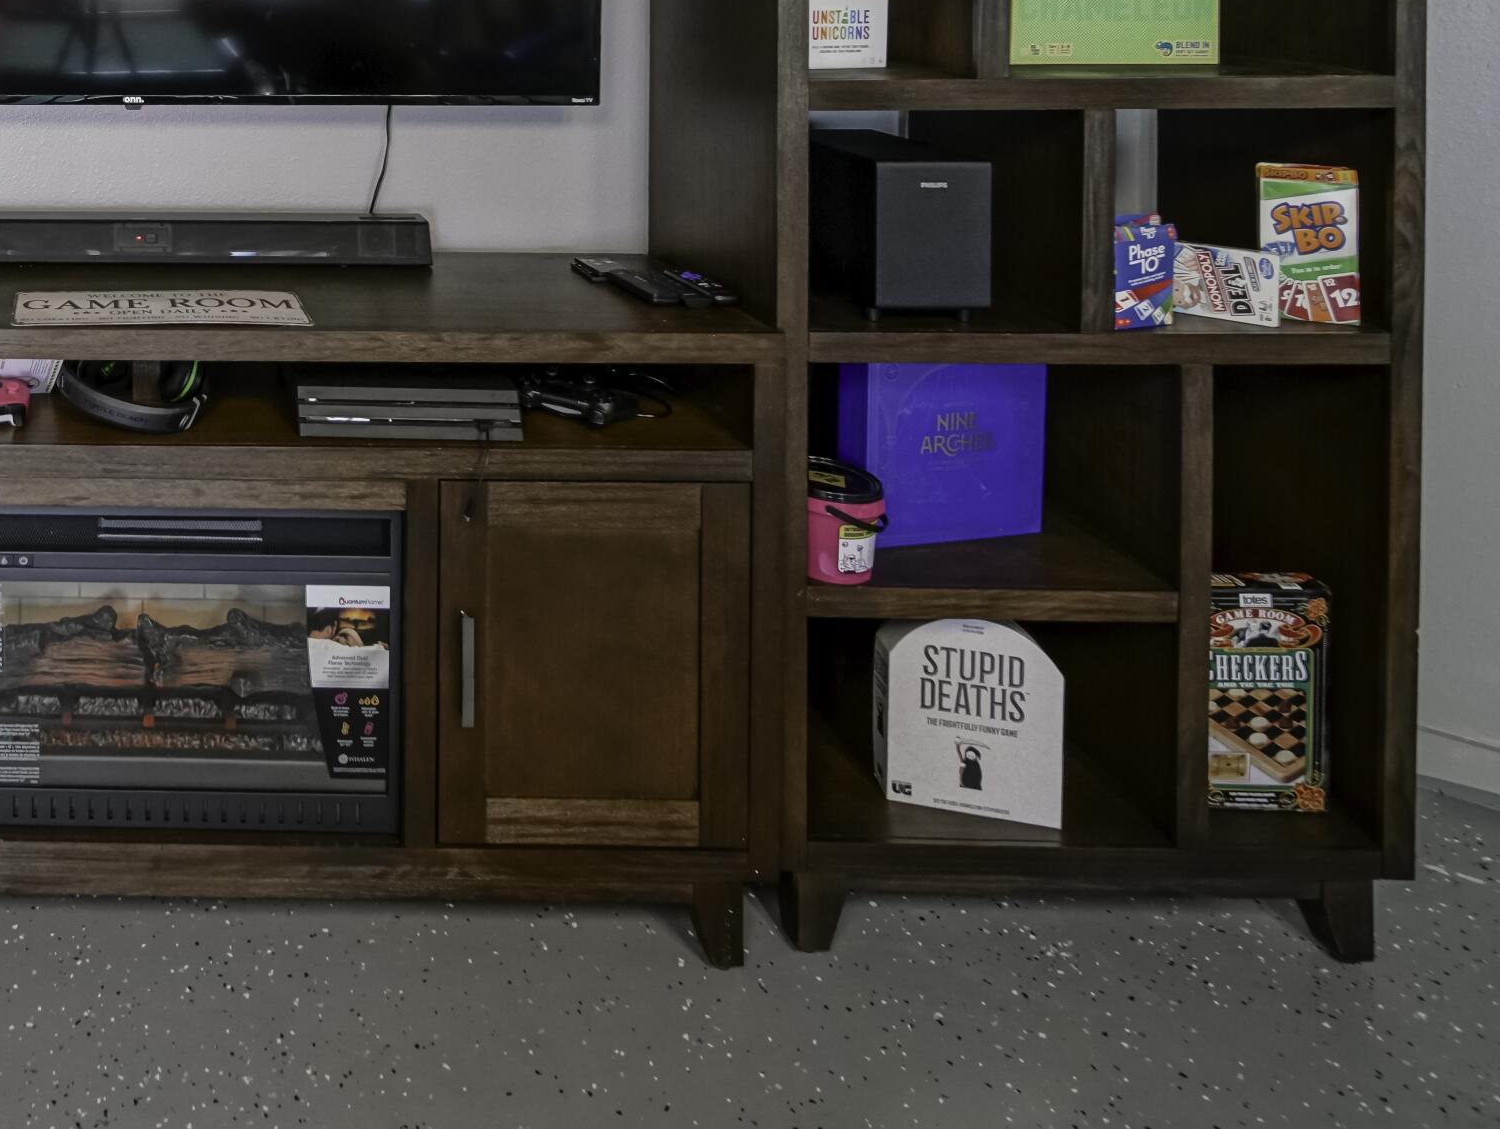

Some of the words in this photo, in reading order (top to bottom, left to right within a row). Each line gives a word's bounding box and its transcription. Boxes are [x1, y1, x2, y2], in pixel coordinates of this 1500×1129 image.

[812, 7, 870, 25] UNSTABLE
[812, 25, 870, 41] UNICORNS
[1176, 41, 1200, 49] BLEND
[122, 96, 145, 104] onn.
[1293, 226, 1347, 255] BO
[1128, 244, 1166, 261] Phase
[1140, 257, 1160, 274] 10
[1198, 252, 1227, 313] MONOPOLY
[1220, 262, 1255, 316] DEAL
[22, 298, 150, 310] GAME
[168, 297, 296, 310] ROOM
[1329, 287, 1360, 308] 12
[937, 411, 978, 432] NINE
[1241, 595, 1268, 605] totes
[1215, 609, 1253, 625] GAME
[1258, 609, 1297, 625] ROOM
[922, 644, 1025, 688] STUPID
[919, 677, 1026, 723] DEATHS
[926, 716, 938, 726] THE
[938, 718, 978, 732] FRIGHTFULLY
[979, 724, 1000, 735] FUNNY
[1001, 728, 1018, 738] GAME
